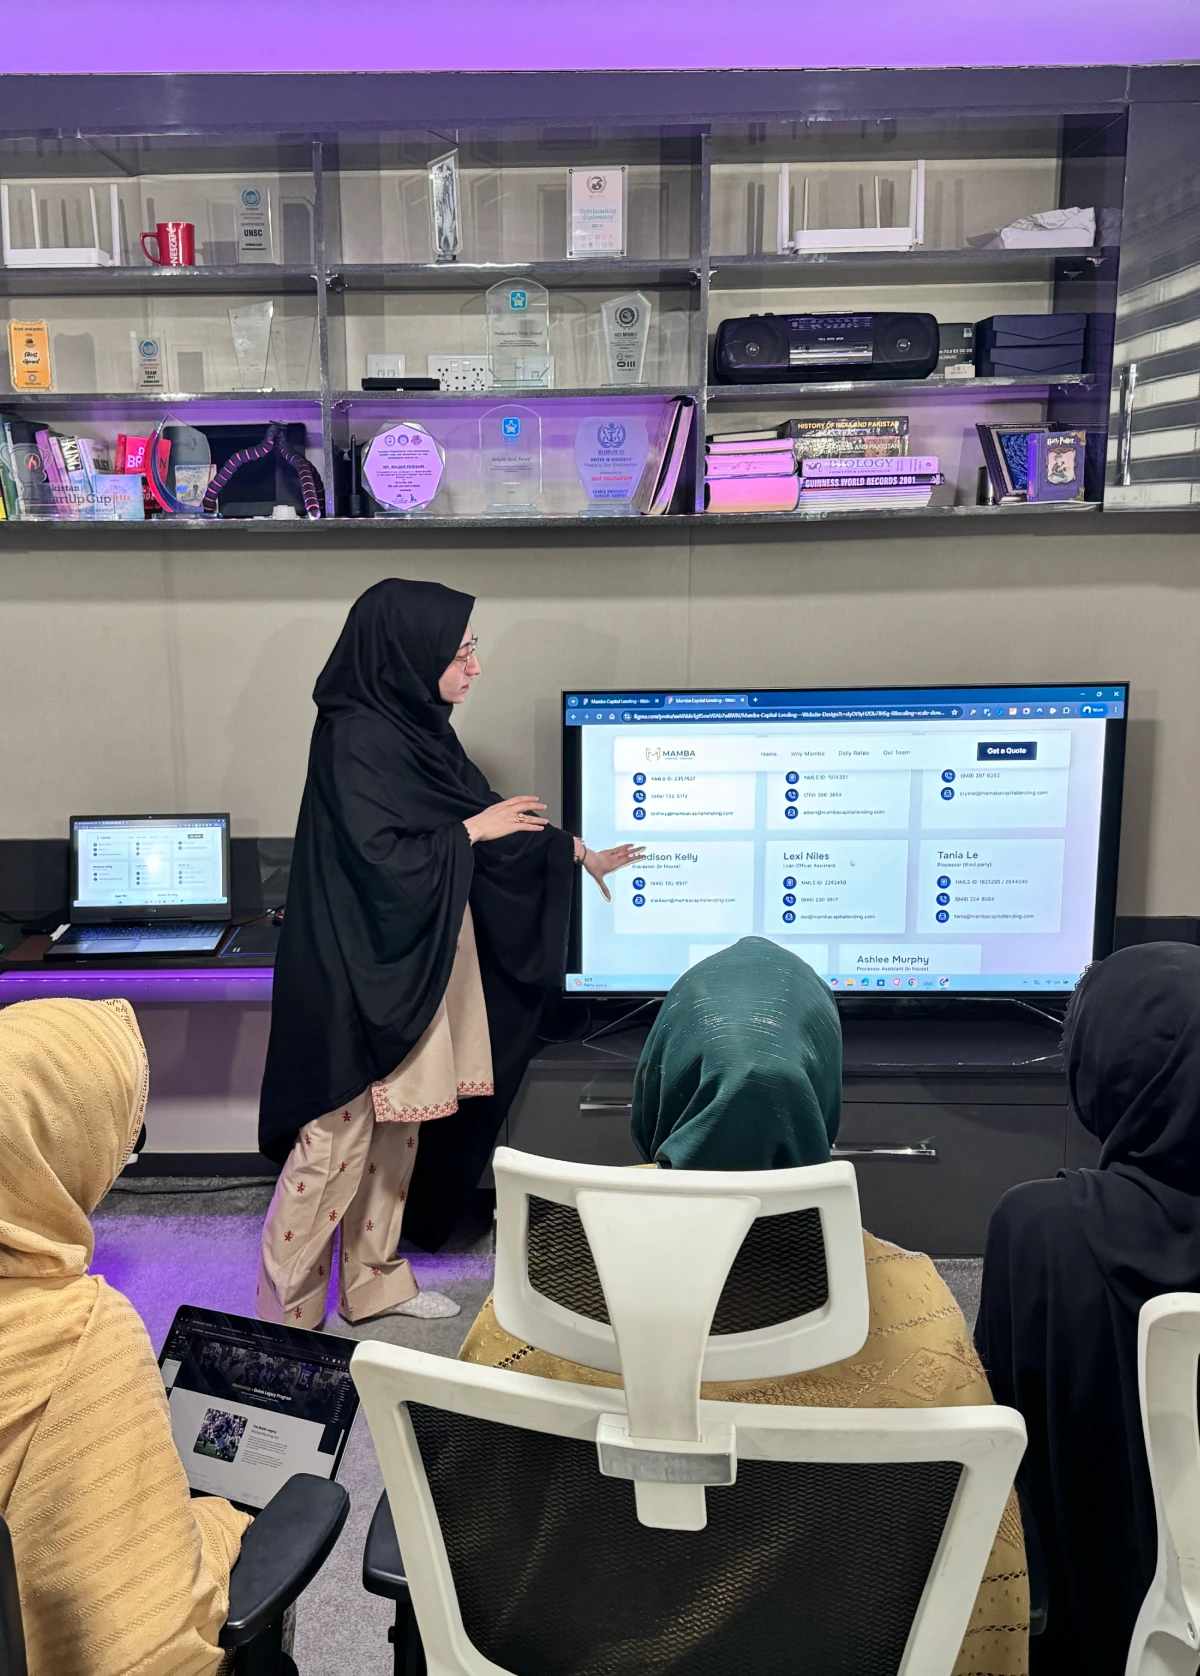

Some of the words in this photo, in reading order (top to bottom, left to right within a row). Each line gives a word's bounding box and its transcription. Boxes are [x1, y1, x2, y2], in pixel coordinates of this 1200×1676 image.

[244, 229, 263, 237] UNSC
[1047, 437, 1059, 446] Harry
[1060, 436, 1074, 445] Potter
[828, 459, 893, 469] BIOLOGY
[805, 479, 841, 487] GUINNESS
[841, 478, 864, 486] WORLD
[866, 477, 897, 486] RECORDS
[899, 476, 916, 484] 2001
[675, 853, 698, 862] Kelly
[784, 852, 803, 860] Lexi
[806, 852, 830, 860] Niles
[938, 851, 963, 859] Tania
[966, 851, 978, 859] Le
[892, 956, 929, 965] Murphy
